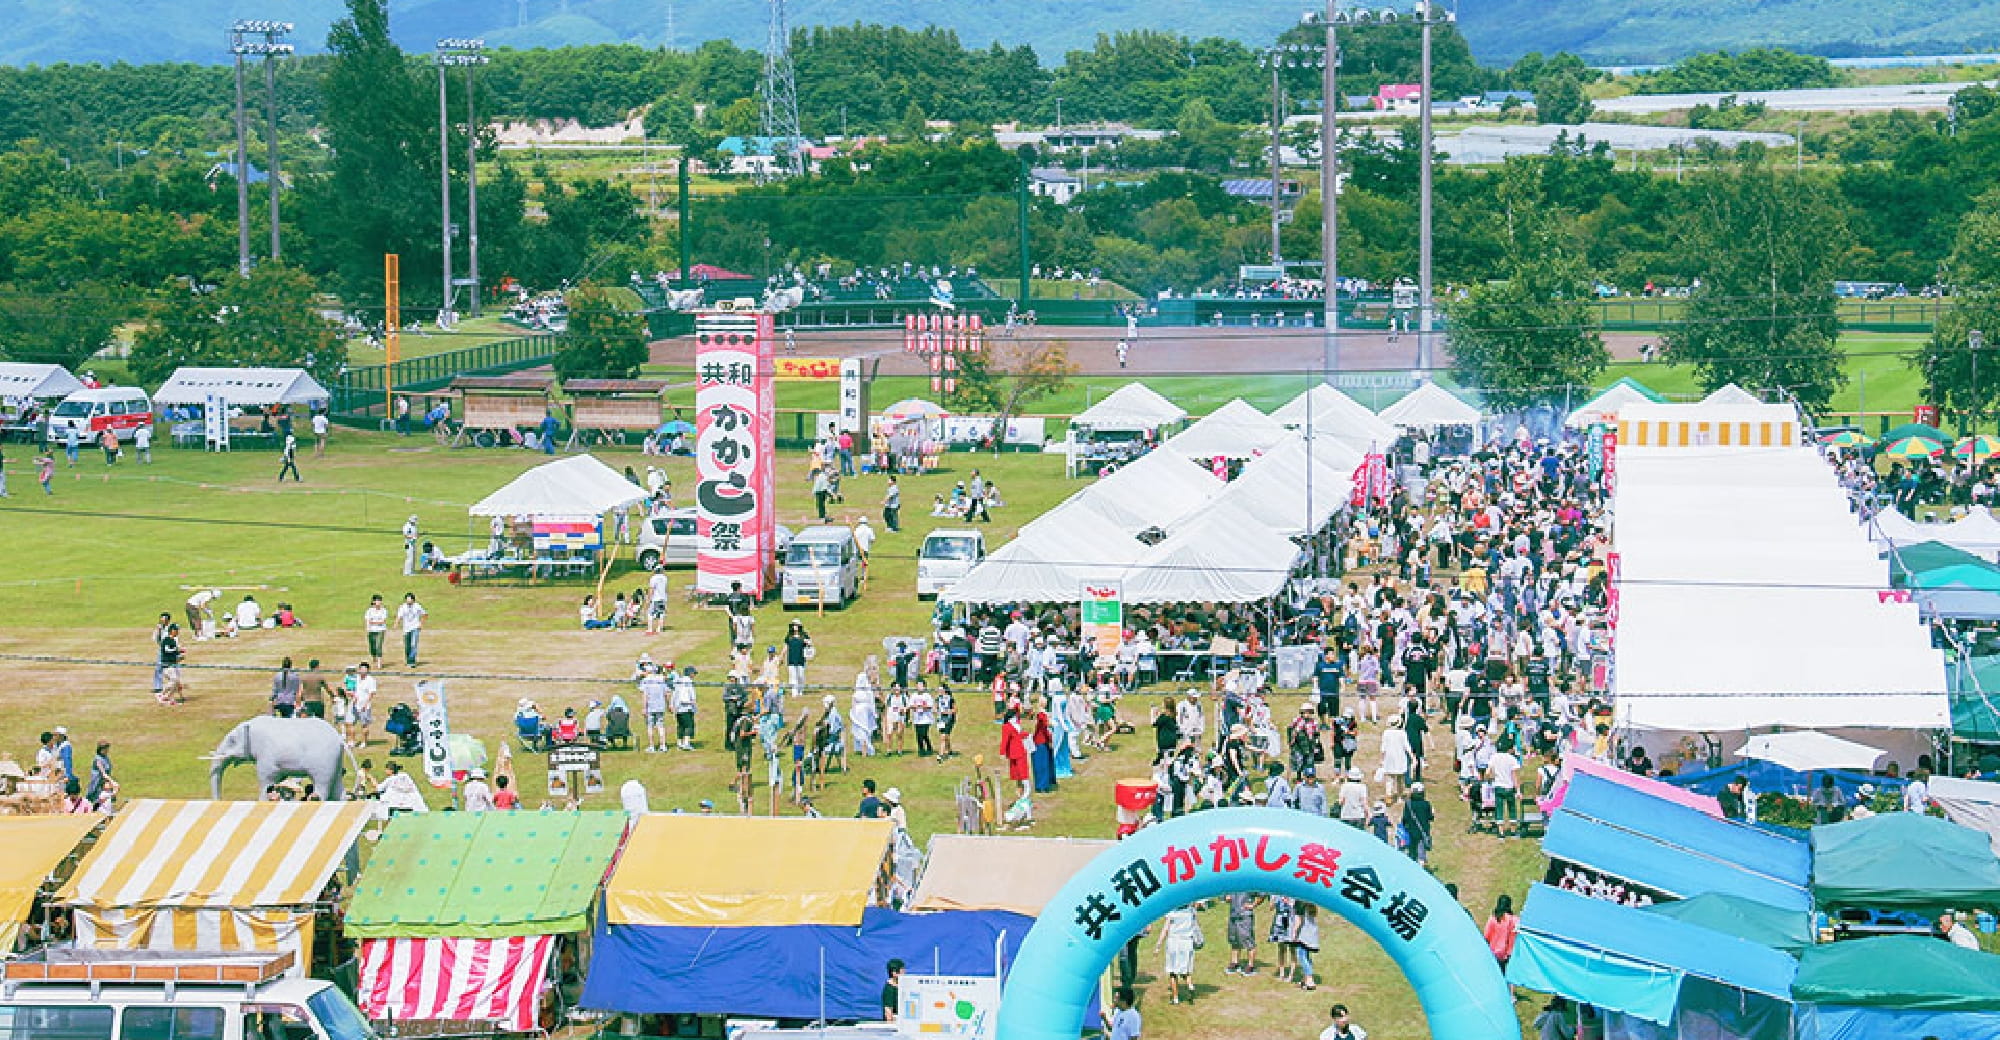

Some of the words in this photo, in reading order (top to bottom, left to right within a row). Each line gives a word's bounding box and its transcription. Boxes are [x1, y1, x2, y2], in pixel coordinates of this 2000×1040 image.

[701, 361, 752, 385] 共和
[698, 404, 755, 551] かかし祭
[1075, 835, 1429, 941] 共和かかし祭会場
